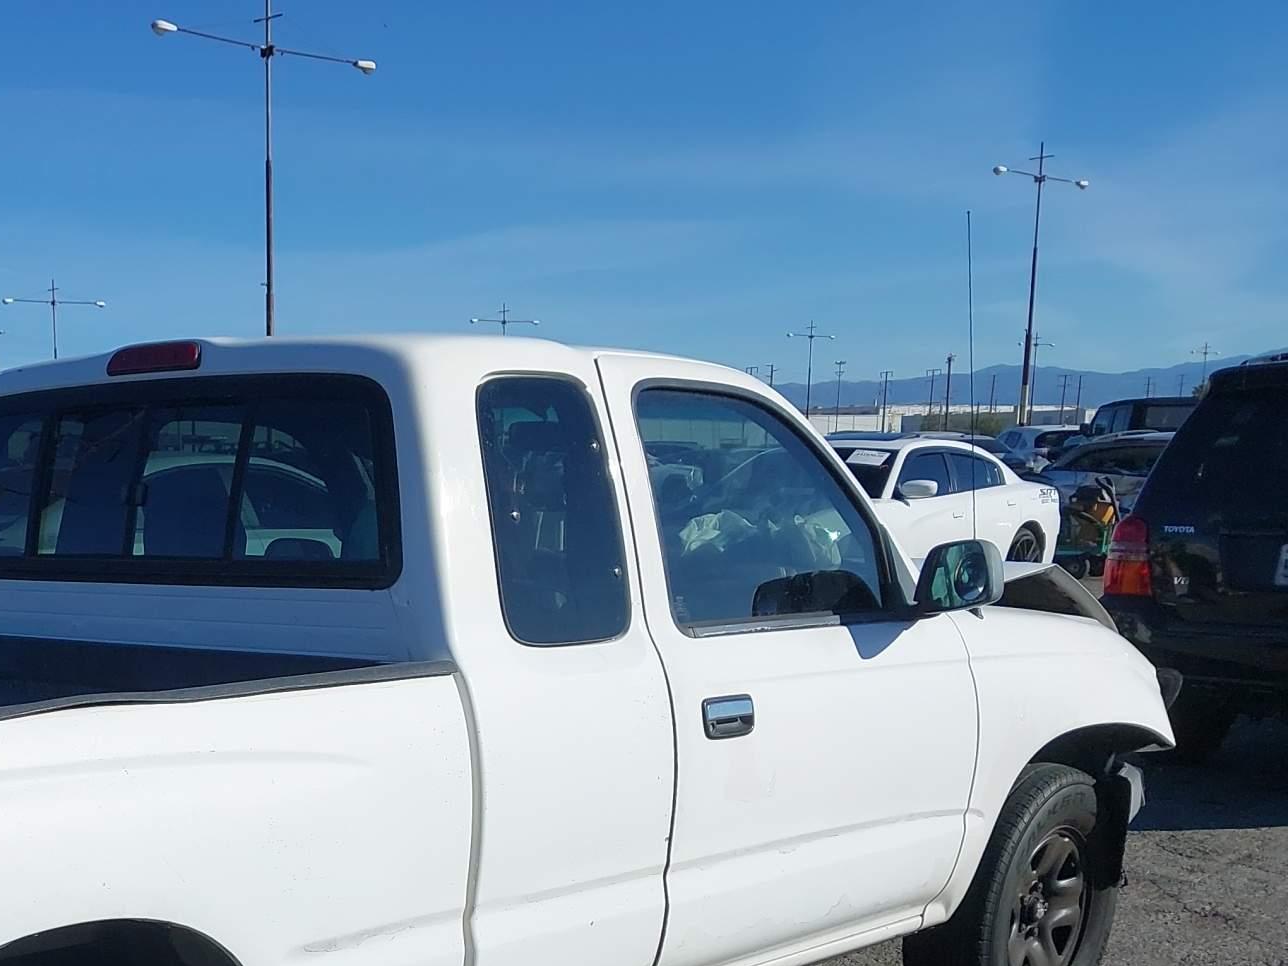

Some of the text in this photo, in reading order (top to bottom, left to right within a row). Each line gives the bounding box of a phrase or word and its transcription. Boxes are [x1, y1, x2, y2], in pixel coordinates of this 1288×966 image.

[1038, 488, 1057, 499] SRT
[1163, 525, 1195, 534] TOYOTA
[1173, 576, 1191, 586] V6
